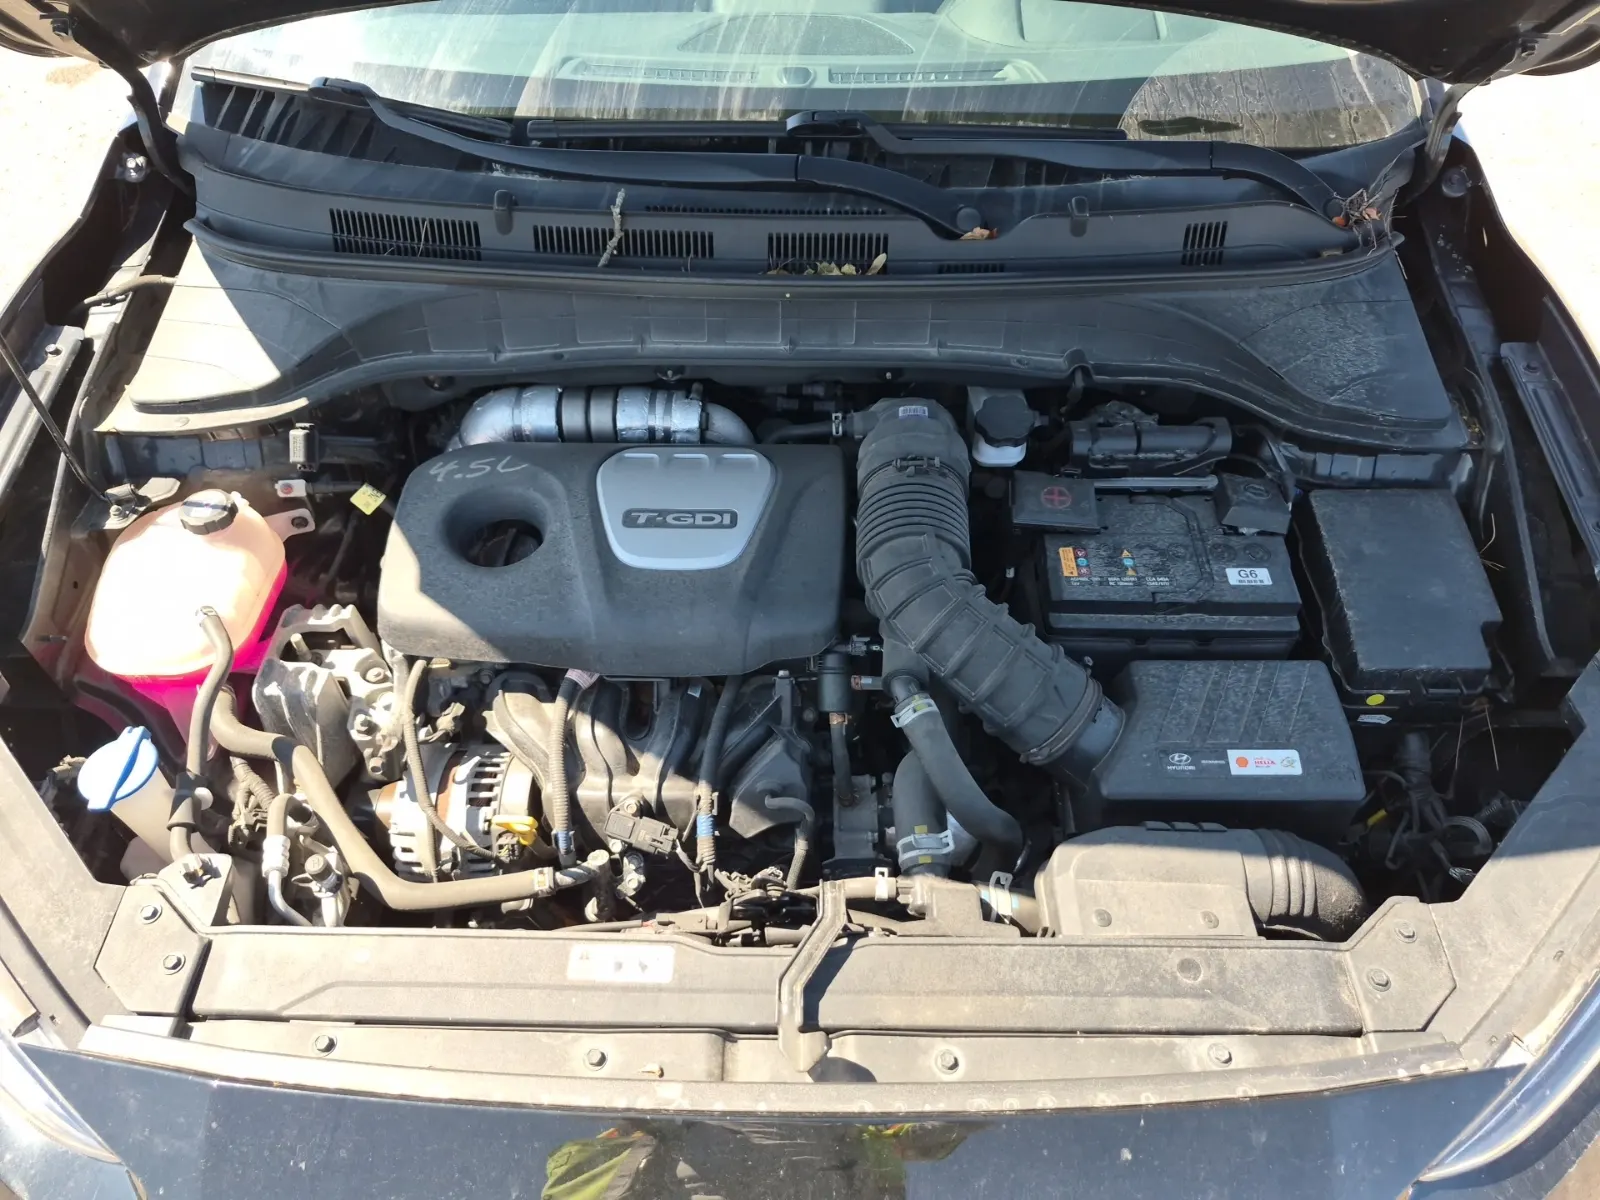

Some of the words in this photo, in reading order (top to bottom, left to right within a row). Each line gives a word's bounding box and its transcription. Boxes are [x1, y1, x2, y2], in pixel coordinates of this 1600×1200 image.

[429, 455, 529, 481] 4.5L
[631, 512, 731, 525] T-GDI
[1238, 569, 1258, 579] G6
